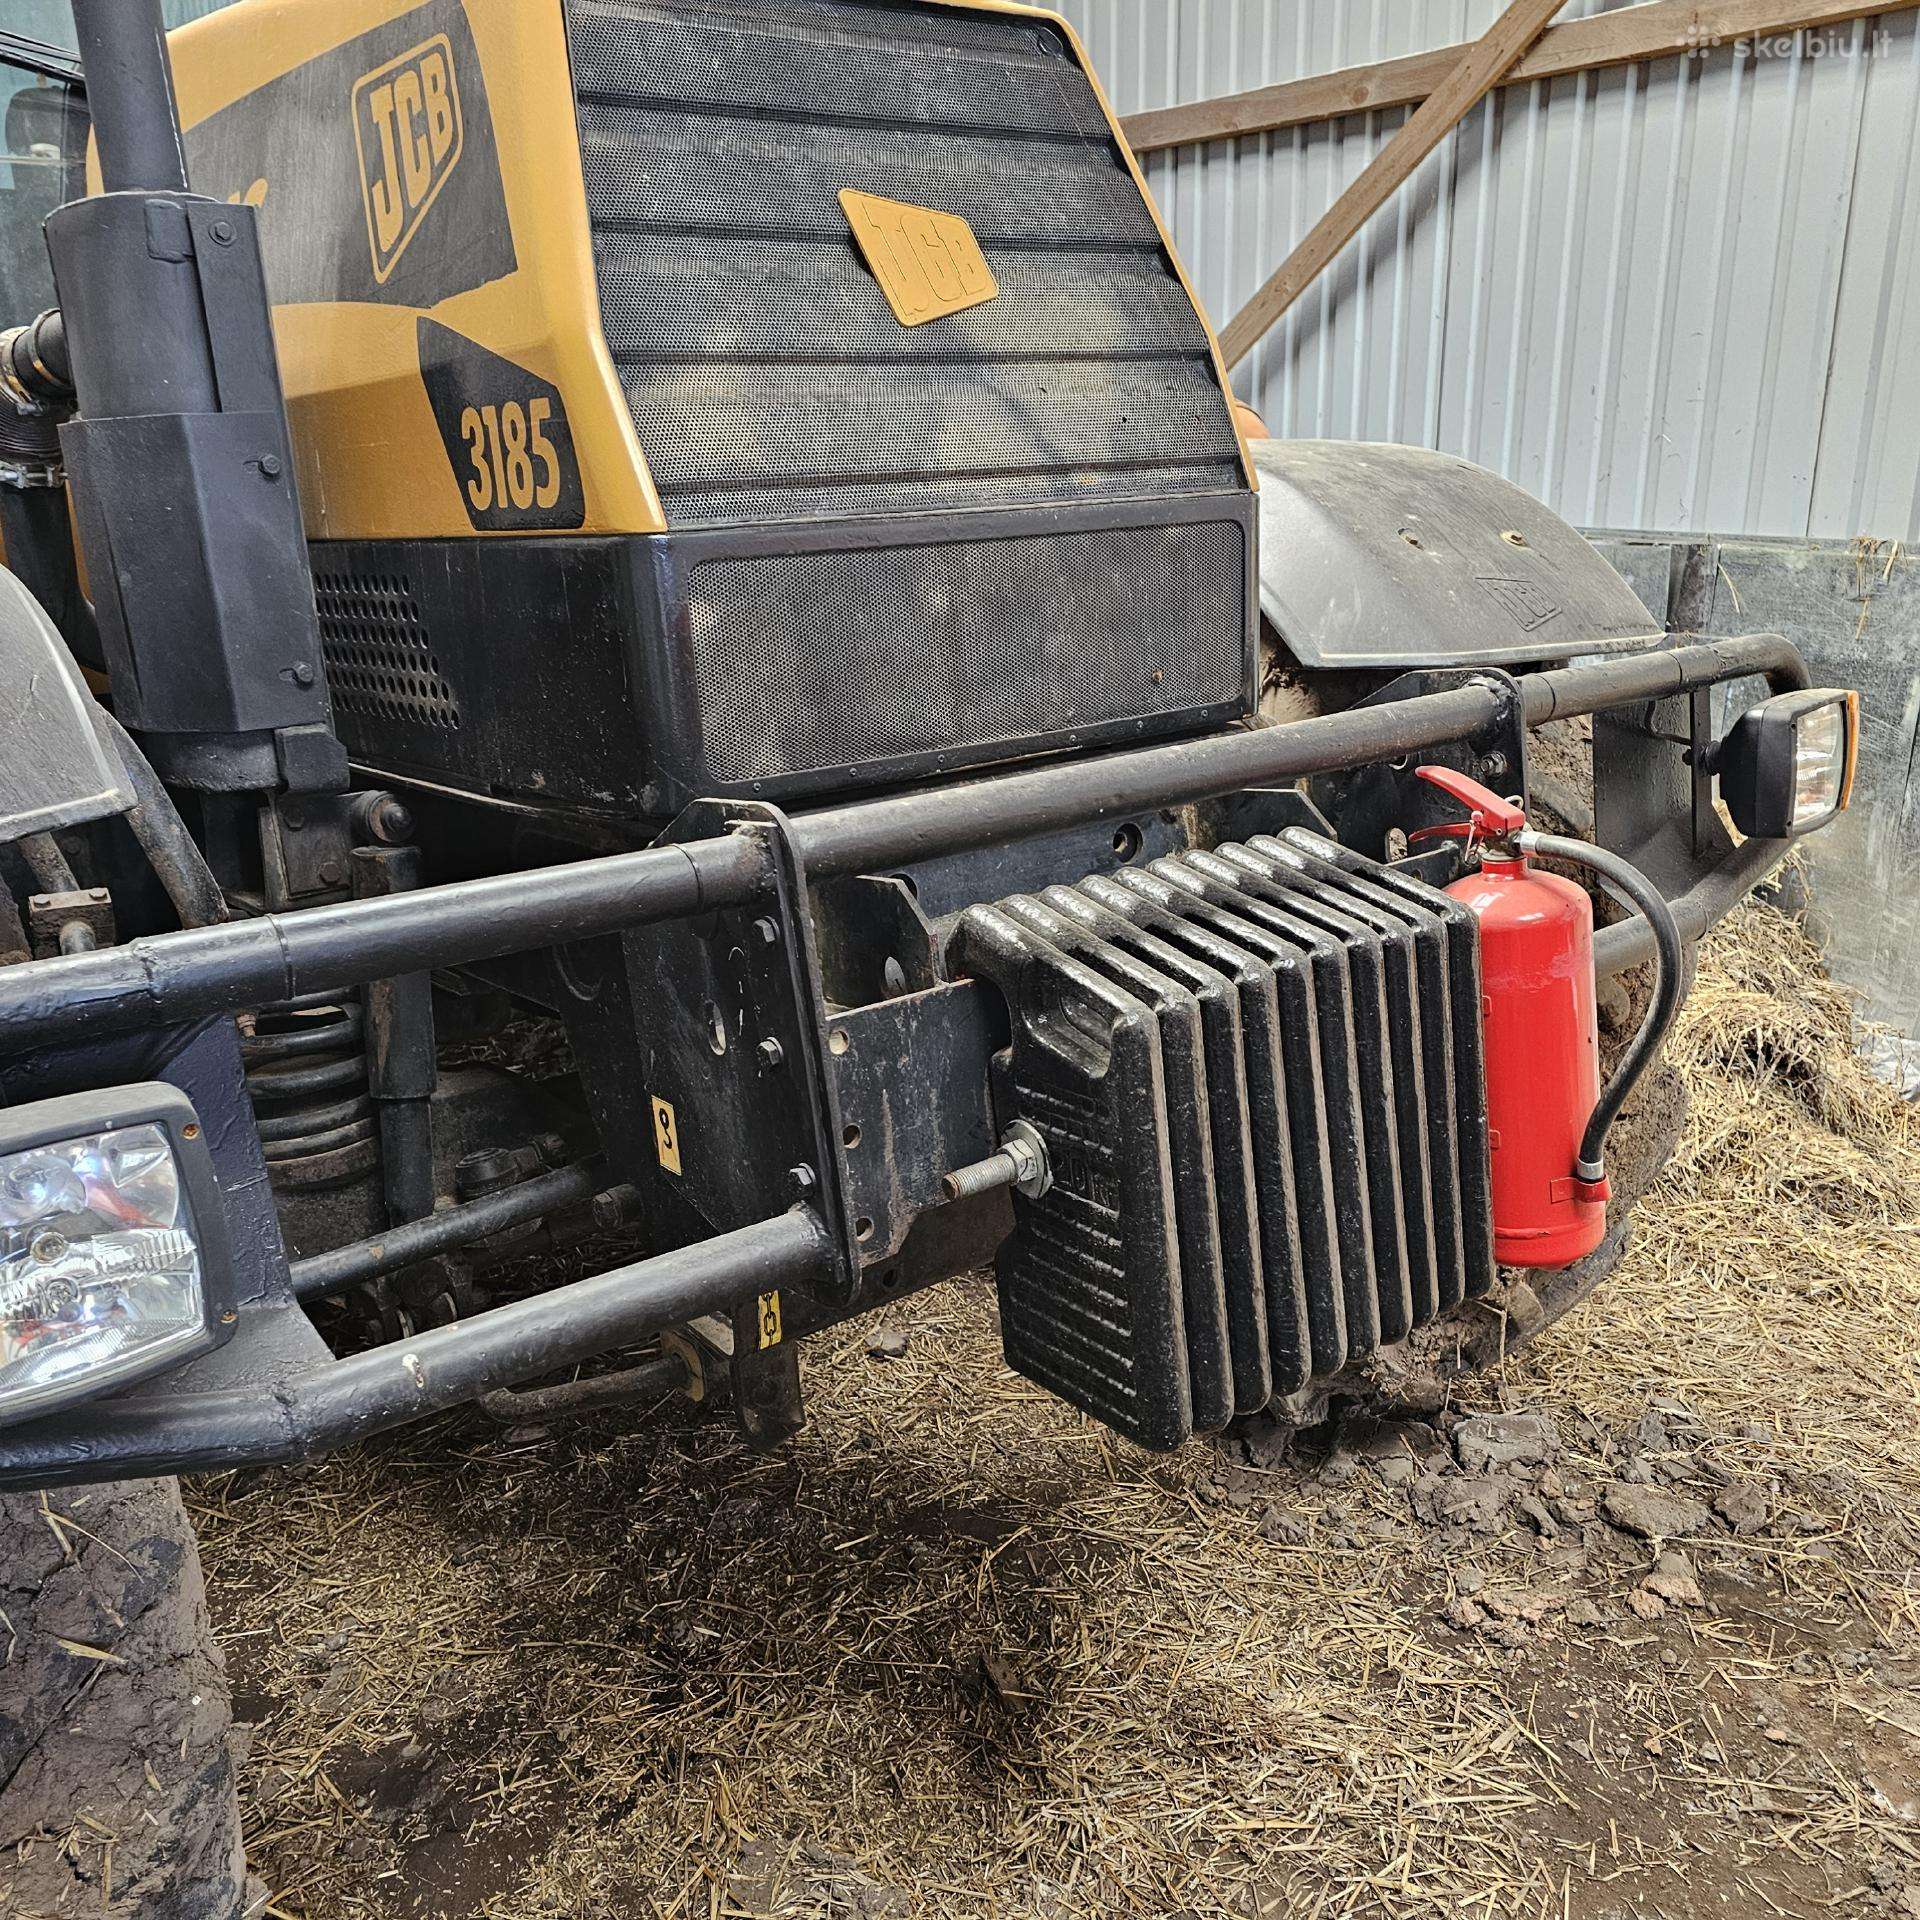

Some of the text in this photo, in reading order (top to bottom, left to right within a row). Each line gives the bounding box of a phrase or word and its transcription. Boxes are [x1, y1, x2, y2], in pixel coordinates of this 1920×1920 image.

[369, 52, 453, 253] JCB
[859, 200, 988, 317] JCB
[461, 396, 560, 511] 3185
